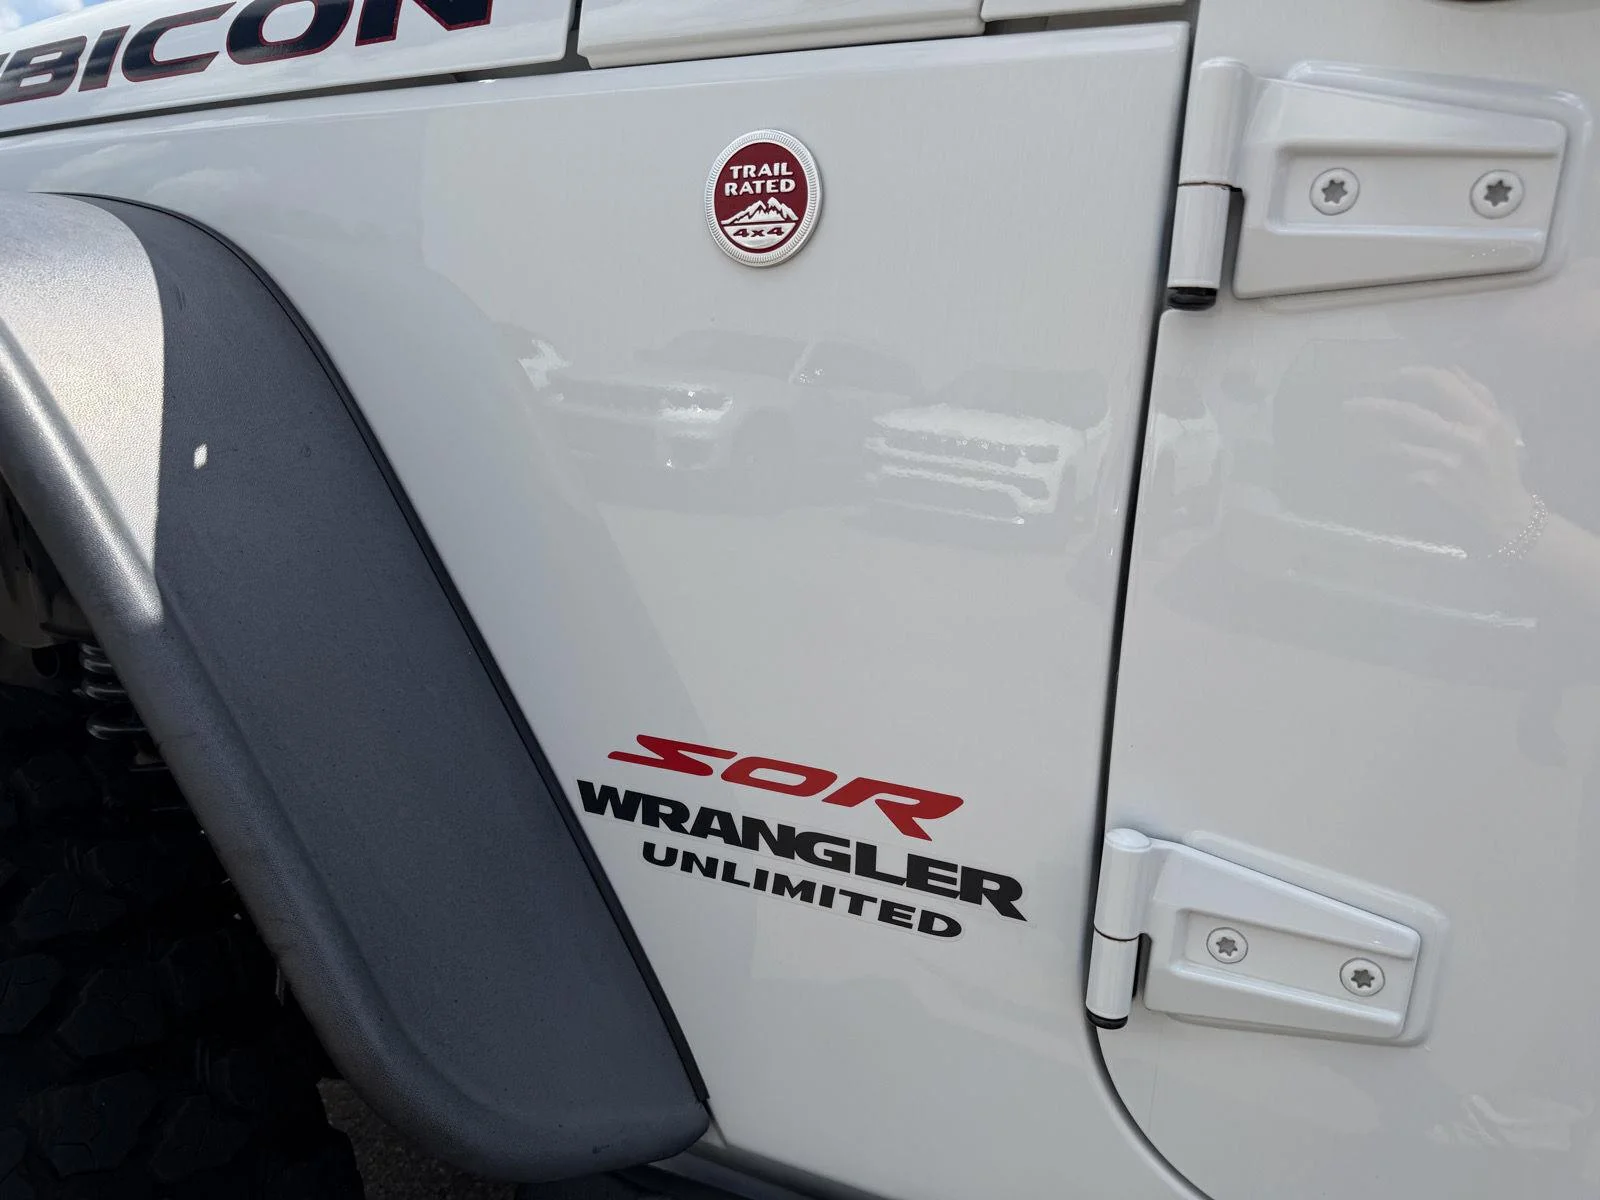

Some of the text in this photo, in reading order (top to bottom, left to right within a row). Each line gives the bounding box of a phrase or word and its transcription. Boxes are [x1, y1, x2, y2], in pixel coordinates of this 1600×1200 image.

[0, 0, 493, 106] BICON
[724, 178, 796, 197] RATED
[729, 162, 794, 180] TRAIL
[732, 226, 785, 238] 4x4
[607, 734, 964, 842] SOR
[576, 779, 1028, 922] WRANGLER
[642, 841, 962, 938] UNLIMITED
